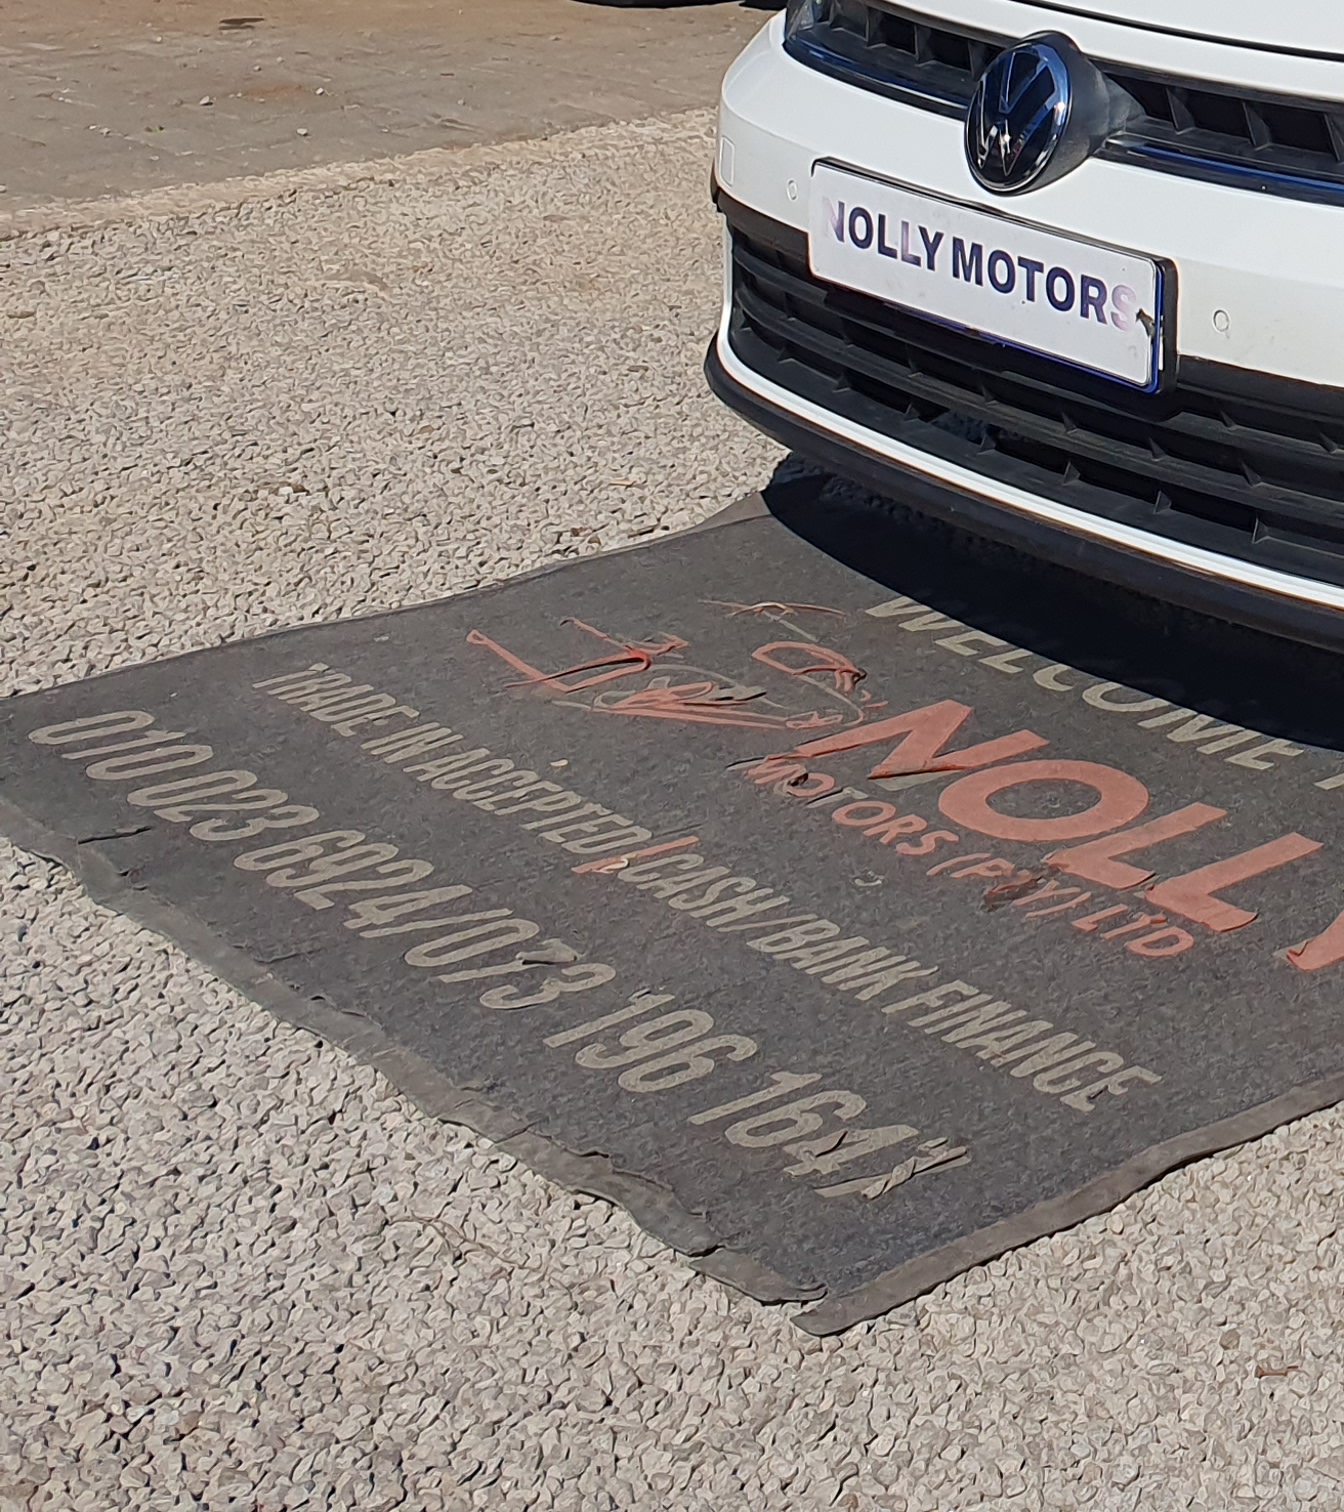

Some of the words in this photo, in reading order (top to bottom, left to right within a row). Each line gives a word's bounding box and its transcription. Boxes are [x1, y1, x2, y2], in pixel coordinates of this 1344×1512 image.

[821, 196, 945, 273] NOLLY
[951, 236, 1140, 333] MOTORS
[252, 662, 421, 737] TRADE
[360, 721, 464, 764] IN
[866, 595, 1304, 770] WELCOME
[402, 747, 653, 855] ACCEPTED
[728, 754, 960, 856] MOTORS
[1072, 903, 1195, 958] LTD
[27, 709, 214, 781] 010
[126, 769, 320, 842] 023
[233, 829, 617, 1010] 6924/073
[543, 988, 759, 1093] 196
[881, 979, 1163, 1112] FINANCE
